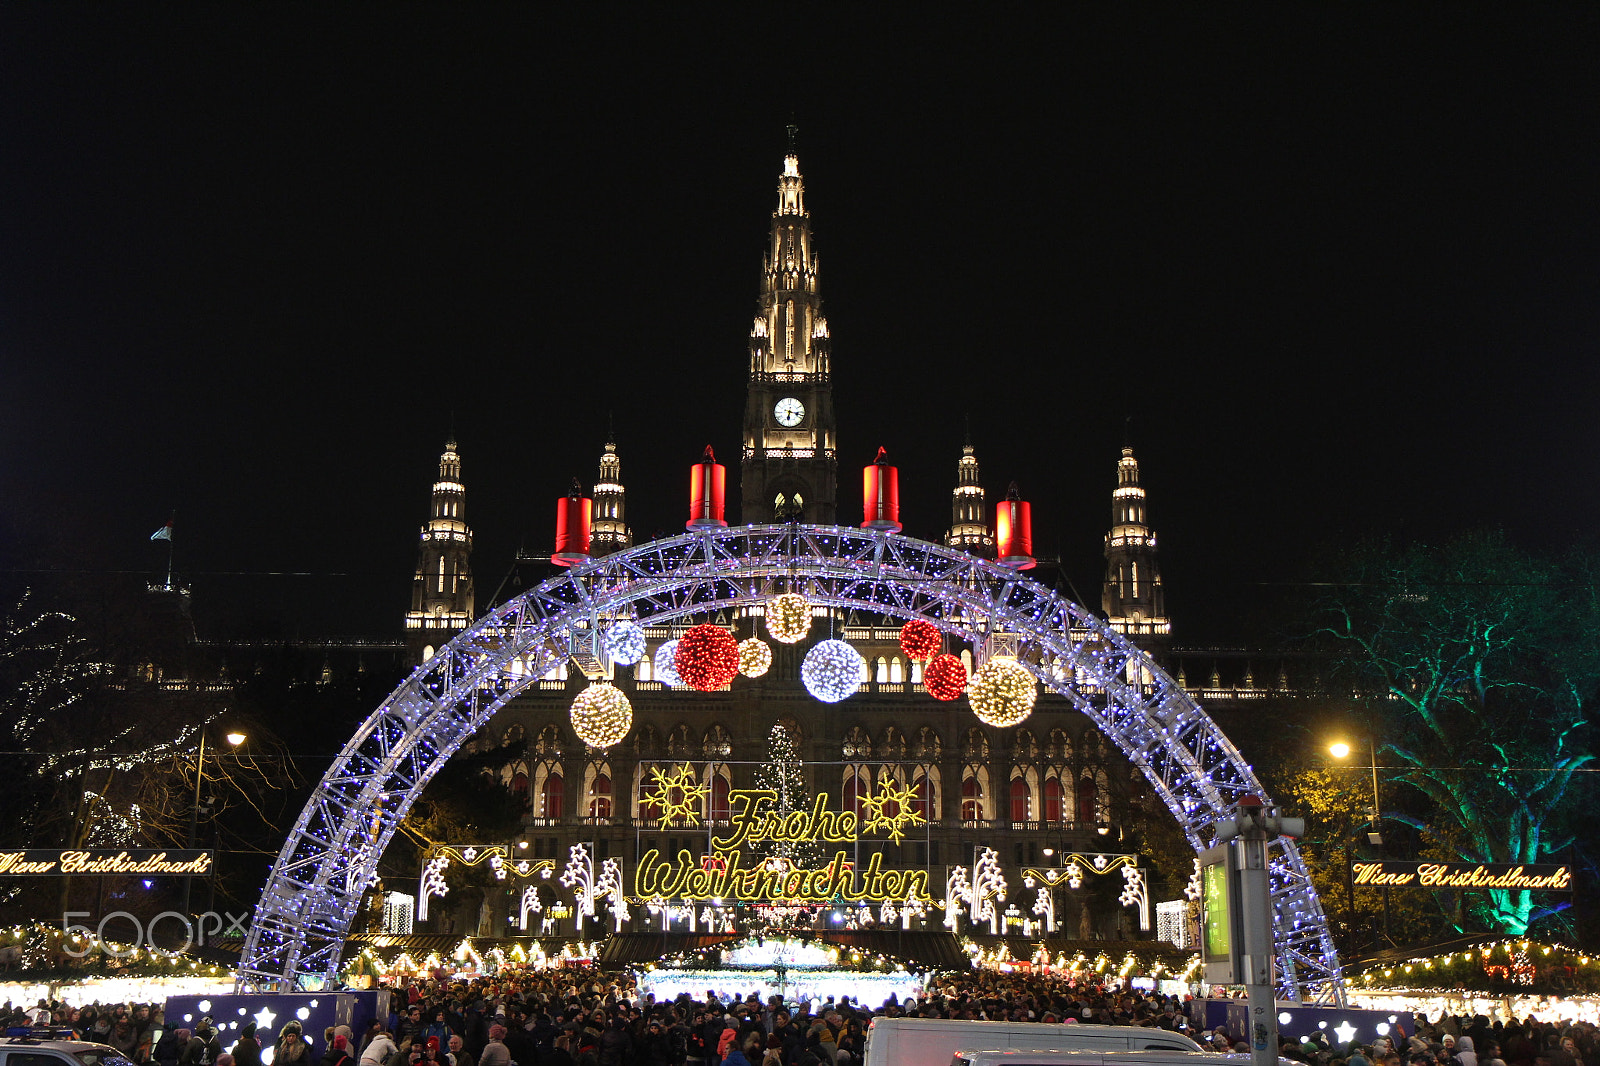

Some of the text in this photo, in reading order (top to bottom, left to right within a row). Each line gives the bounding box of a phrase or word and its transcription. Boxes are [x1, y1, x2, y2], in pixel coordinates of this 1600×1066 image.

[712, 790, 858, 849] Frohe
[0, 851, 212, 874] Wiener Christkindlmarkt
[635, 849, 931, 901] Weihnachten
[1352, 863, 1571, 888] Wiener Christkindlmarkt
